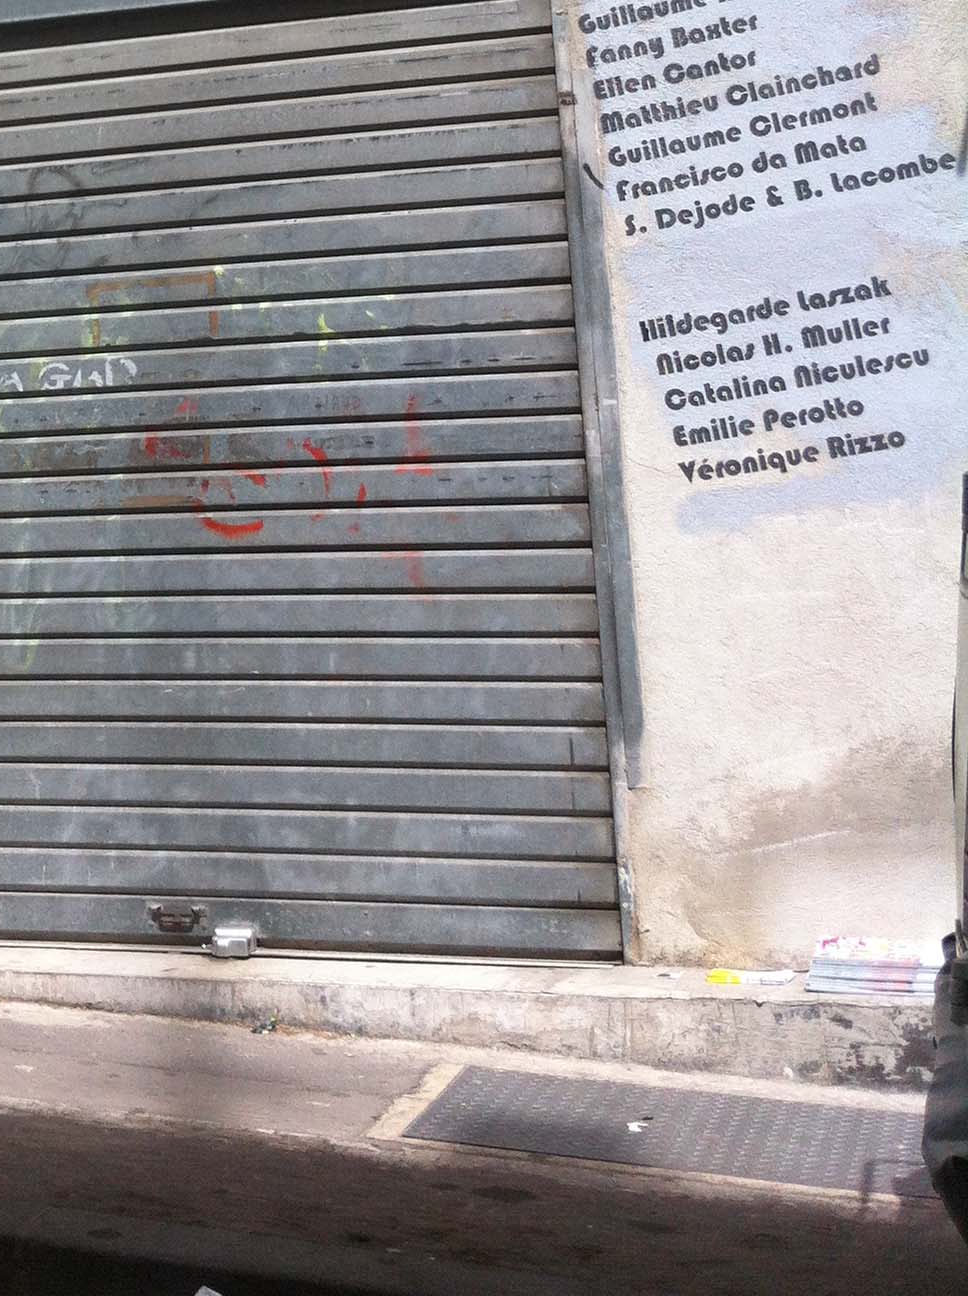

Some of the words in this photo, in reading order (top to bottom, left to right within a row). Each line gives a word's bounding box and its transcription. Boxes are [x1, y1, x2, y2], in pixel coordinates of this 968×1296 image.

[586, 36, 664, 68] Fanny
[671, 15, 758, 48] Baxter
[593, 72, 657, 100] Ellen
[662, 50, 756, 84] Cantor
[601, 96, 719, 134] Matthieu
[726, 53, 880, 106] Clainchard
[608, 126, 742, 167] Guillaume
[749, 92, 878, 136] Clermont
[616, 164, 744, 201] Francisco
[752, 151, 787, 174] da
[794, 135, 867, 164] Mata
[625, 214, 648, 236] S.
[655, 194, 755, 229] Dejode
[766, 186, 784, 207] &
[793, 179, 823, 202] B.
[832, 153, 957, 192] Lacombe
[640, 298, 790, 342] Hildegarde
[798, 276, 892, 311] Laszak
[657, 344, 755, 375] Nicolas
[763, 334, 793, 356] H.
[801, 318, 890, 349] Muller
[664, 375, 787, 411] Catalina
[794, 348, 929, 389] Niculescu
[673, 416, 755, 447] Emilie
[763, 398, 864, 432] Perotto
[679, 443, 819, 484] Véronique
[827, 430, 906, 459] Rizzo
